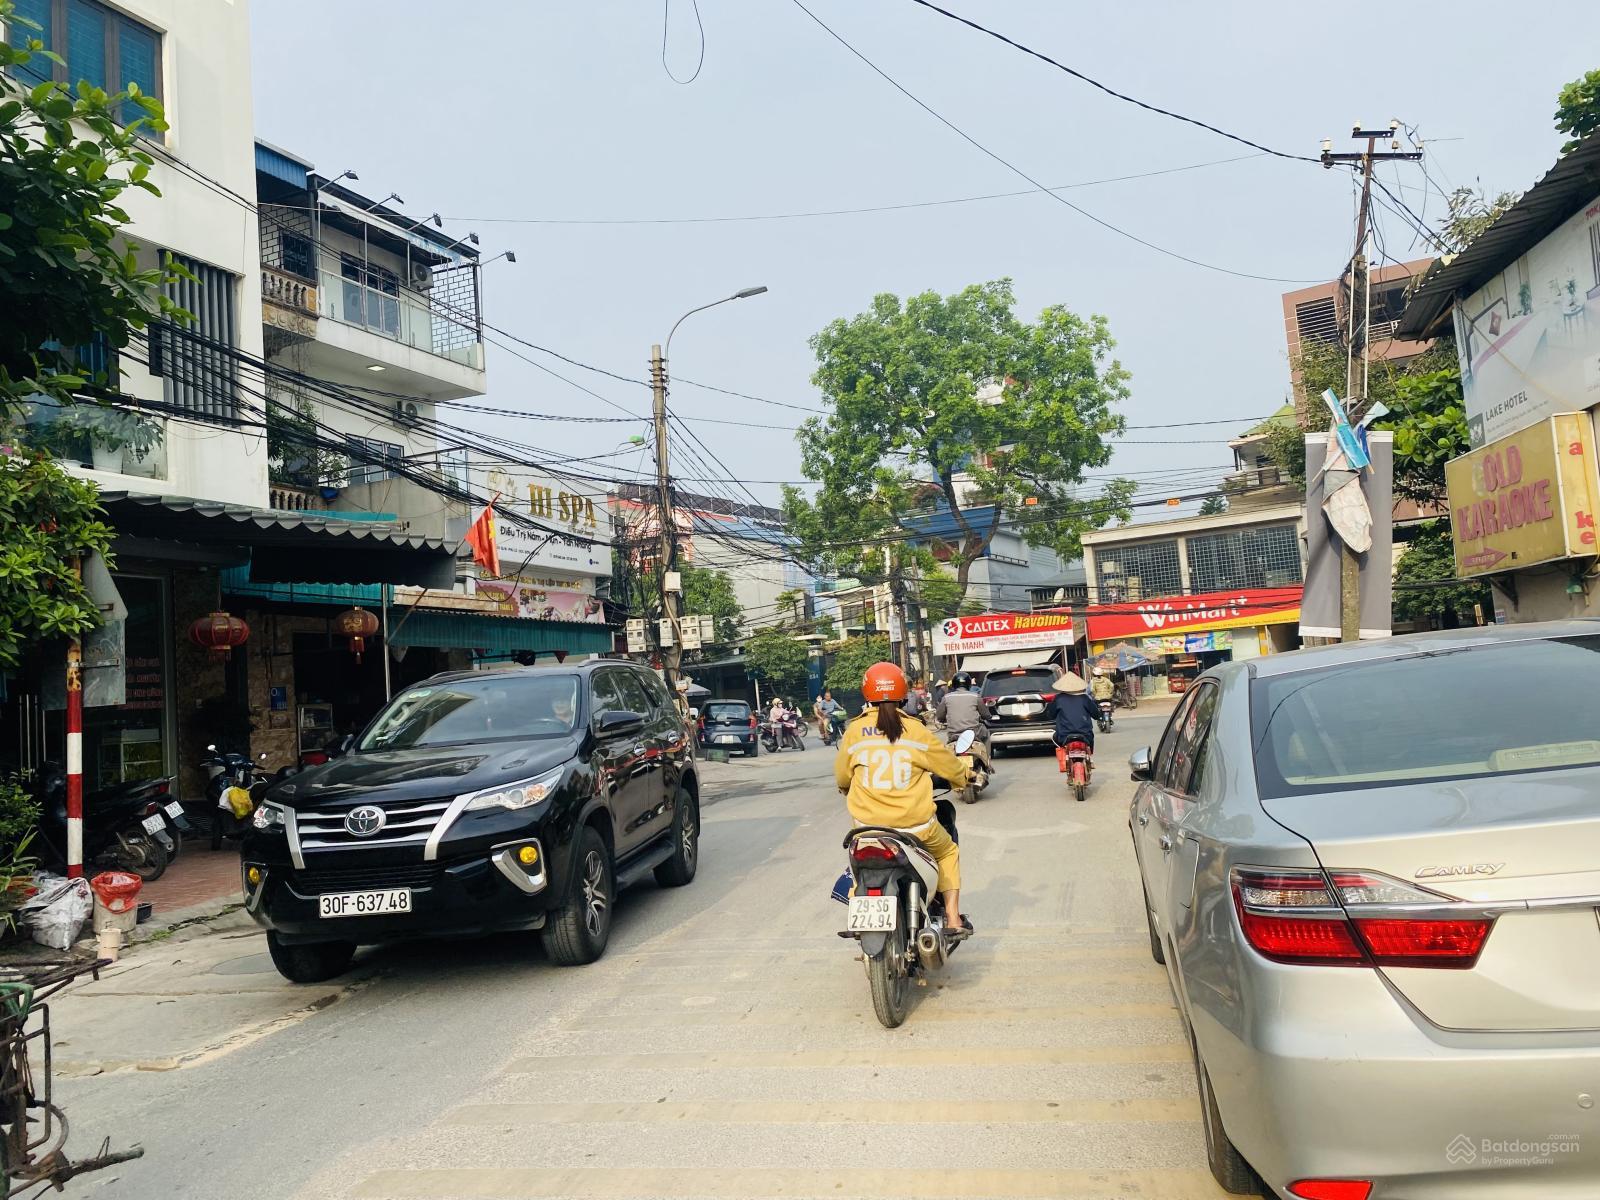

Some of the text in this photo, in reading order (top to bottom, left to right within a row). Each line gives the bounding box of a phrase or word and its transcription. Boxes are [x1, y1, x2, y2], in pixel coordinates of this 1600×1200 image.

[1485, 402, 1503, 421] LAKE
[1504, 391, 1528, 412] HOTEL
[1482, 445, 1523, 492] OLD
[526, 483, 596, 528] HI SPA
[1457, 479, 1554, 542] KARAOKE
[965, 615, 1069, 633] CALTEX Havoline
[859, 749, 912, 790] 126
[1415, 863, 1506, 878] CAMRY
[322, 892, 408, 914] 30F-637.48
[857, 899, 889, 913] 29-S6
[852, 914, 892, 928] 224.94
